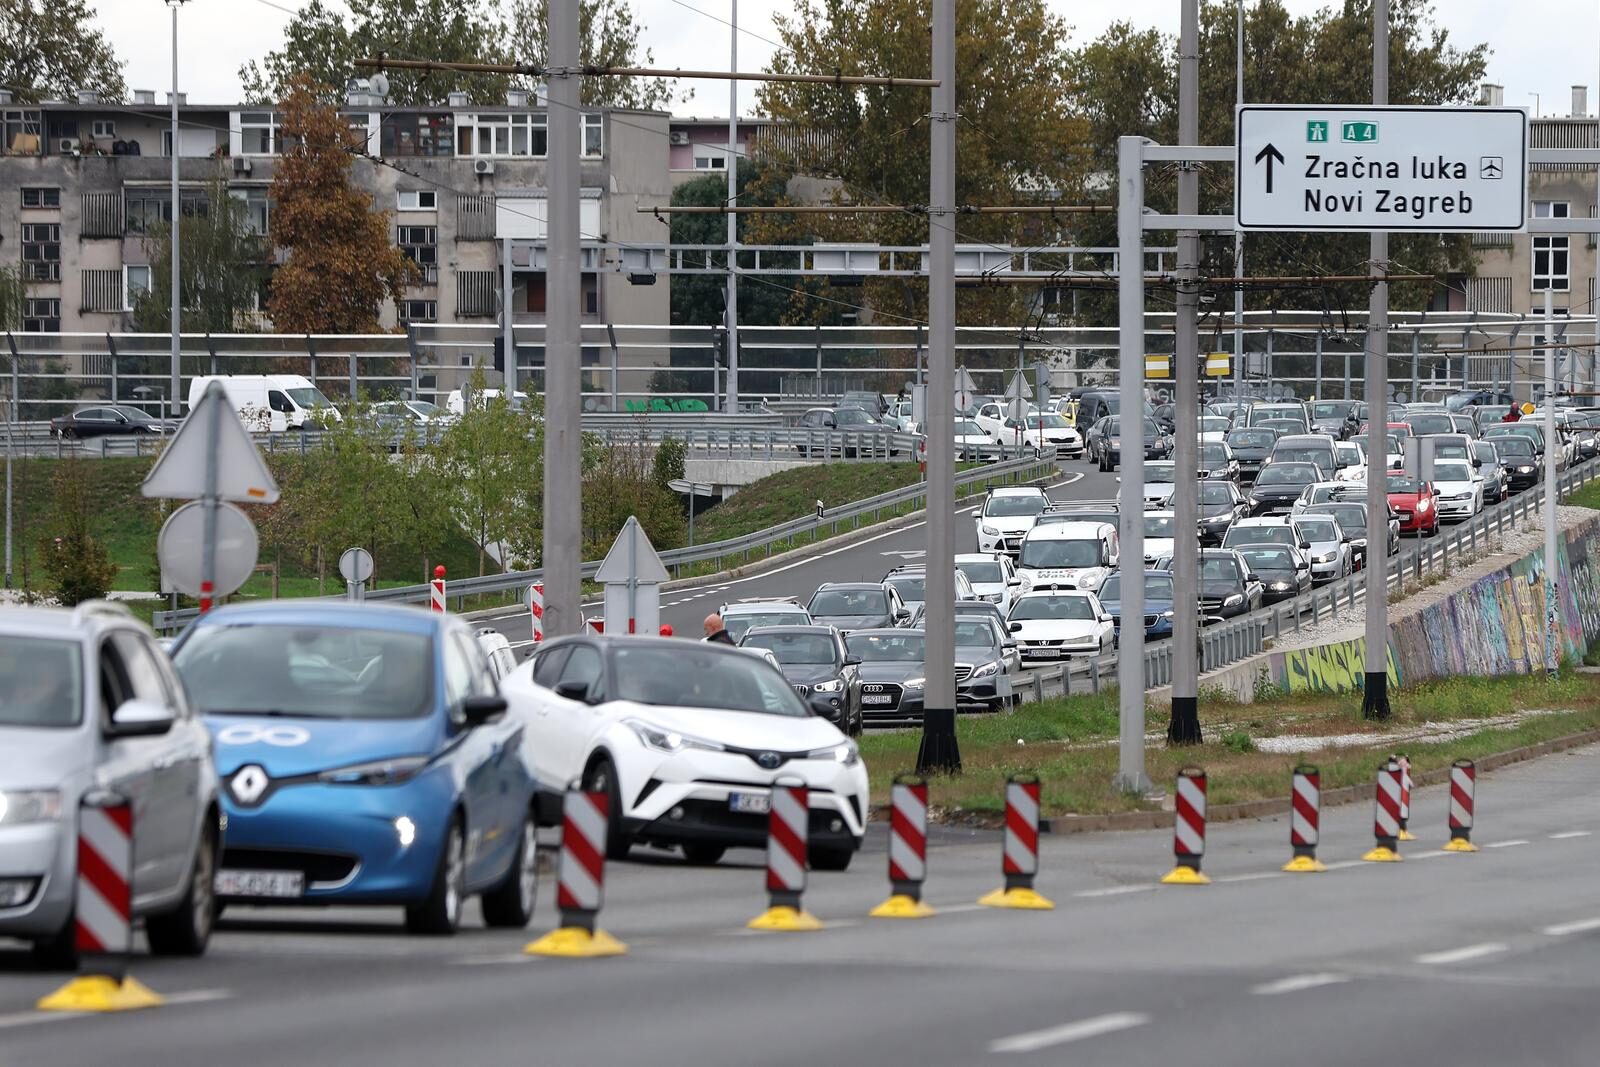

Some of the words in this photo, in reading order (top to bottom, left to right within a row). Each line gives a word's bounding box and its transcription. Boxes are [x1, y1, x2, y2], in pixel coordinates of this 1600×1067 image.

[1347, 125, 1356, 139] A
[1363, 125, 1372, 139] 4
[1304, 155, 1400, 179] Zračna
[1412, 155, 1467, 179] luka
[1304, 189, 1363, 212] Novi
[1375, 189, 1473, 219] Zagreb
